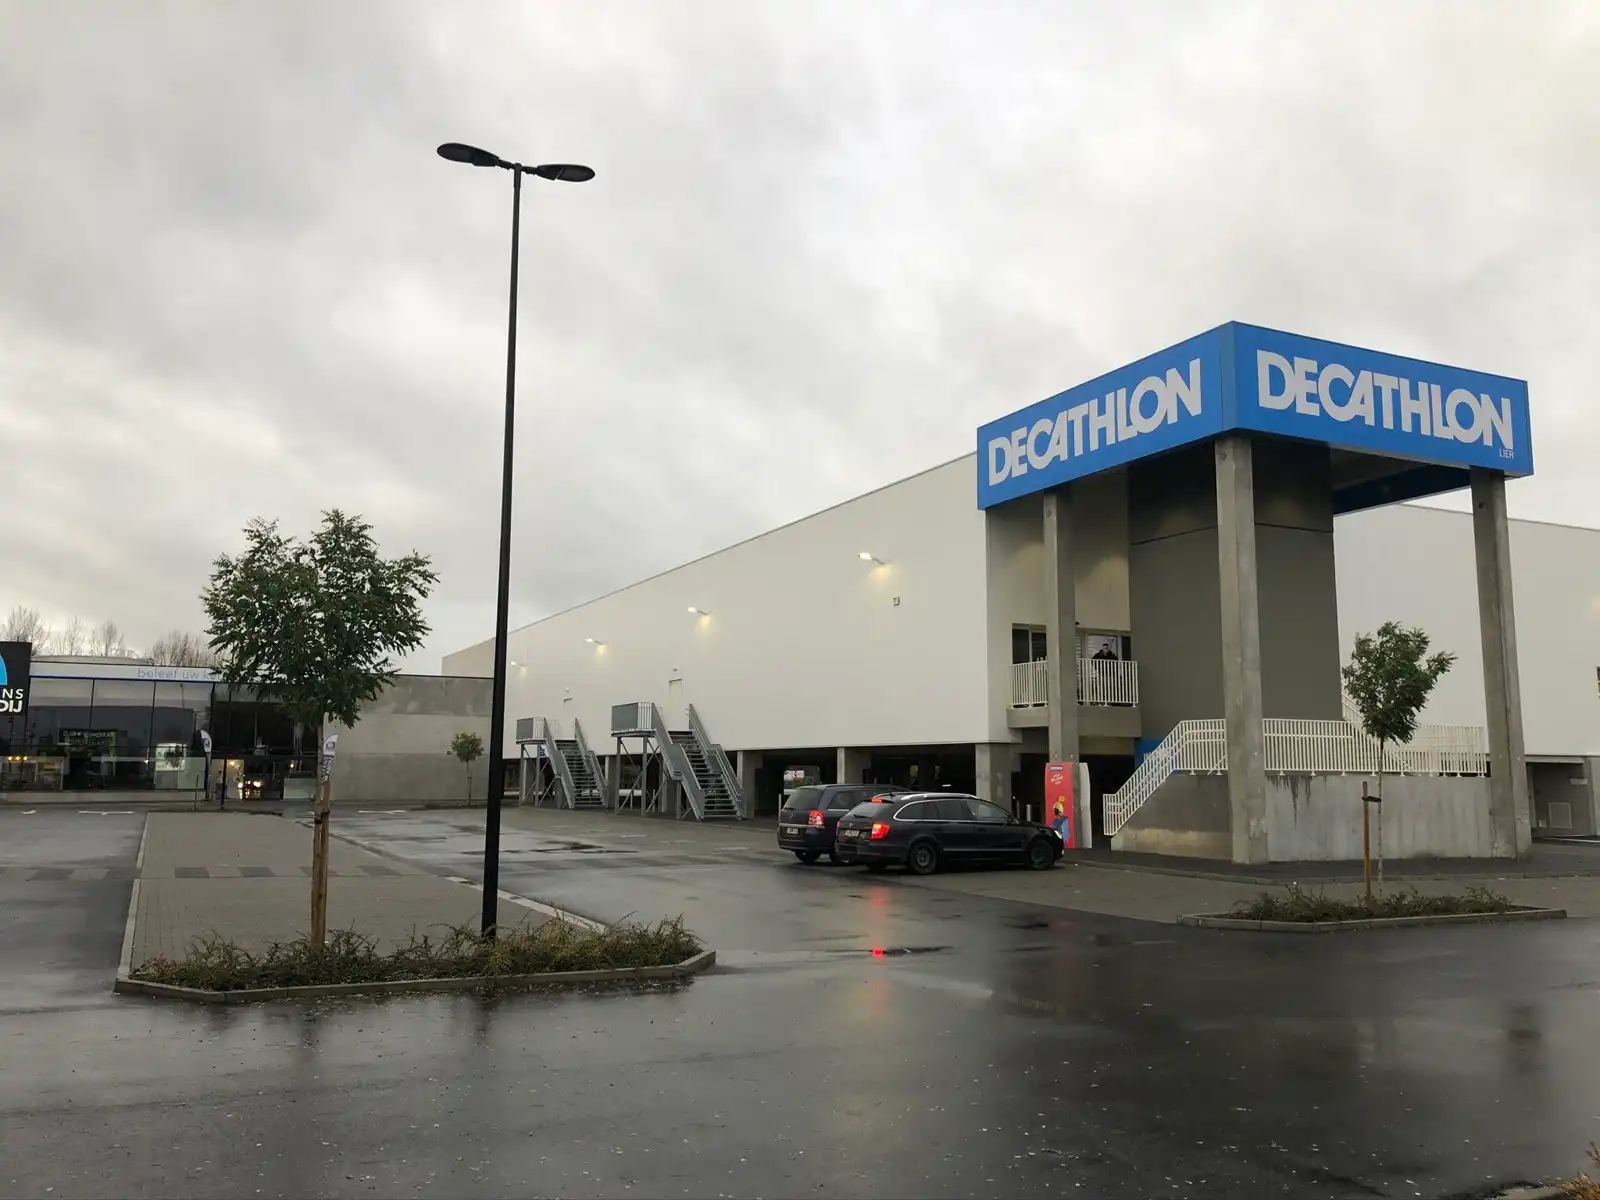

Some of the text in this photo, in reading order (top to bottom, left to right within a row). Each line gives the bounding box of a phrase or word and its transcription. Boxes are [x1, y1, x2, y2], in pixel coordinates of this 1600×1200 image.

[988, 358, 1202, 487] DECATHLON
[1256, 349, 1514, 450] DECATHLON
[1498, 448, 1515, 460] LIER
